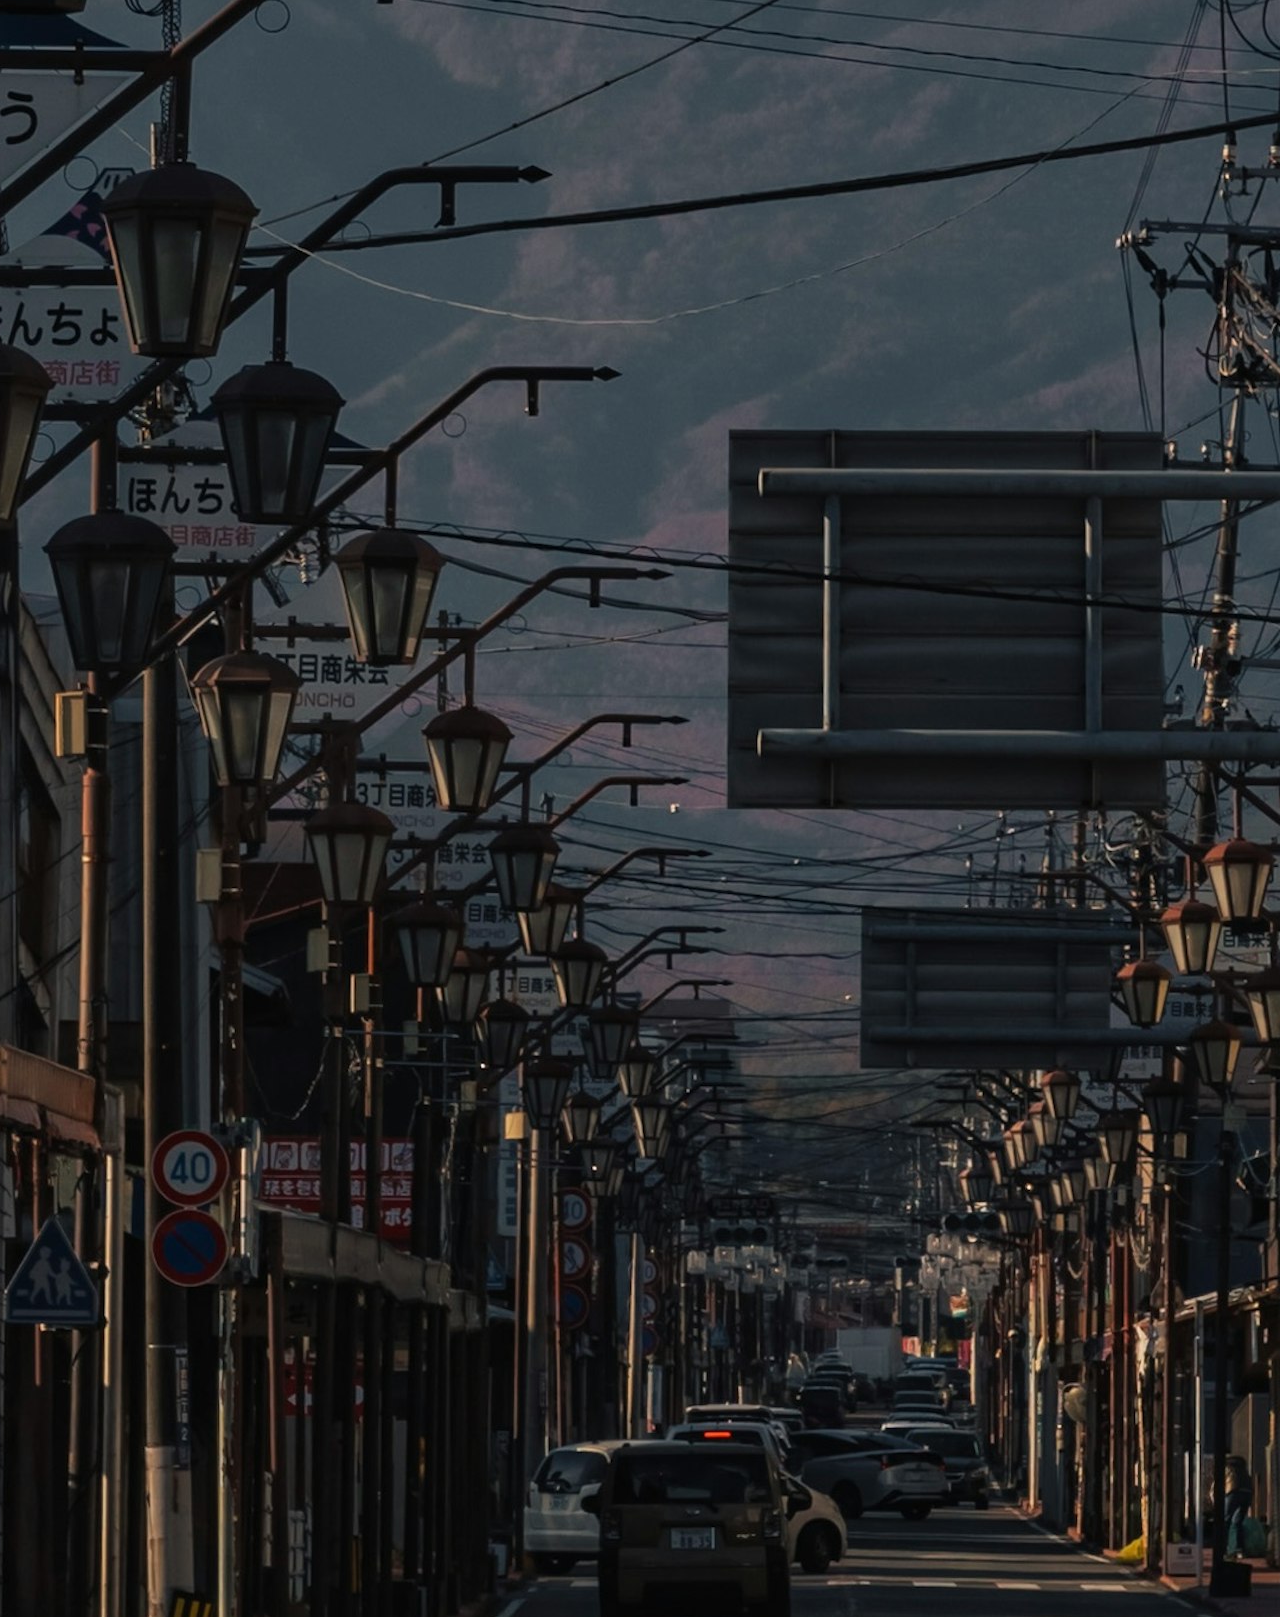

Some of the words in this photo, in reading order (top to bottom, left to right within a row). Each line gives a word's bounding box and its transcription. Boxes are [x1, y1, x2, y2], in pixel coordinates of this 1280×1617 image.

[44, 359, 120, 387] 商店街
[128, 477, 238, 514] ほんち
[160, 525, 256, 548] 目商店街
[261, 653, 388, 684] 丁目商栄会
[357, 783, 436, 808] 3丁目商栄
[171, 1151, 211, 1184] 40
